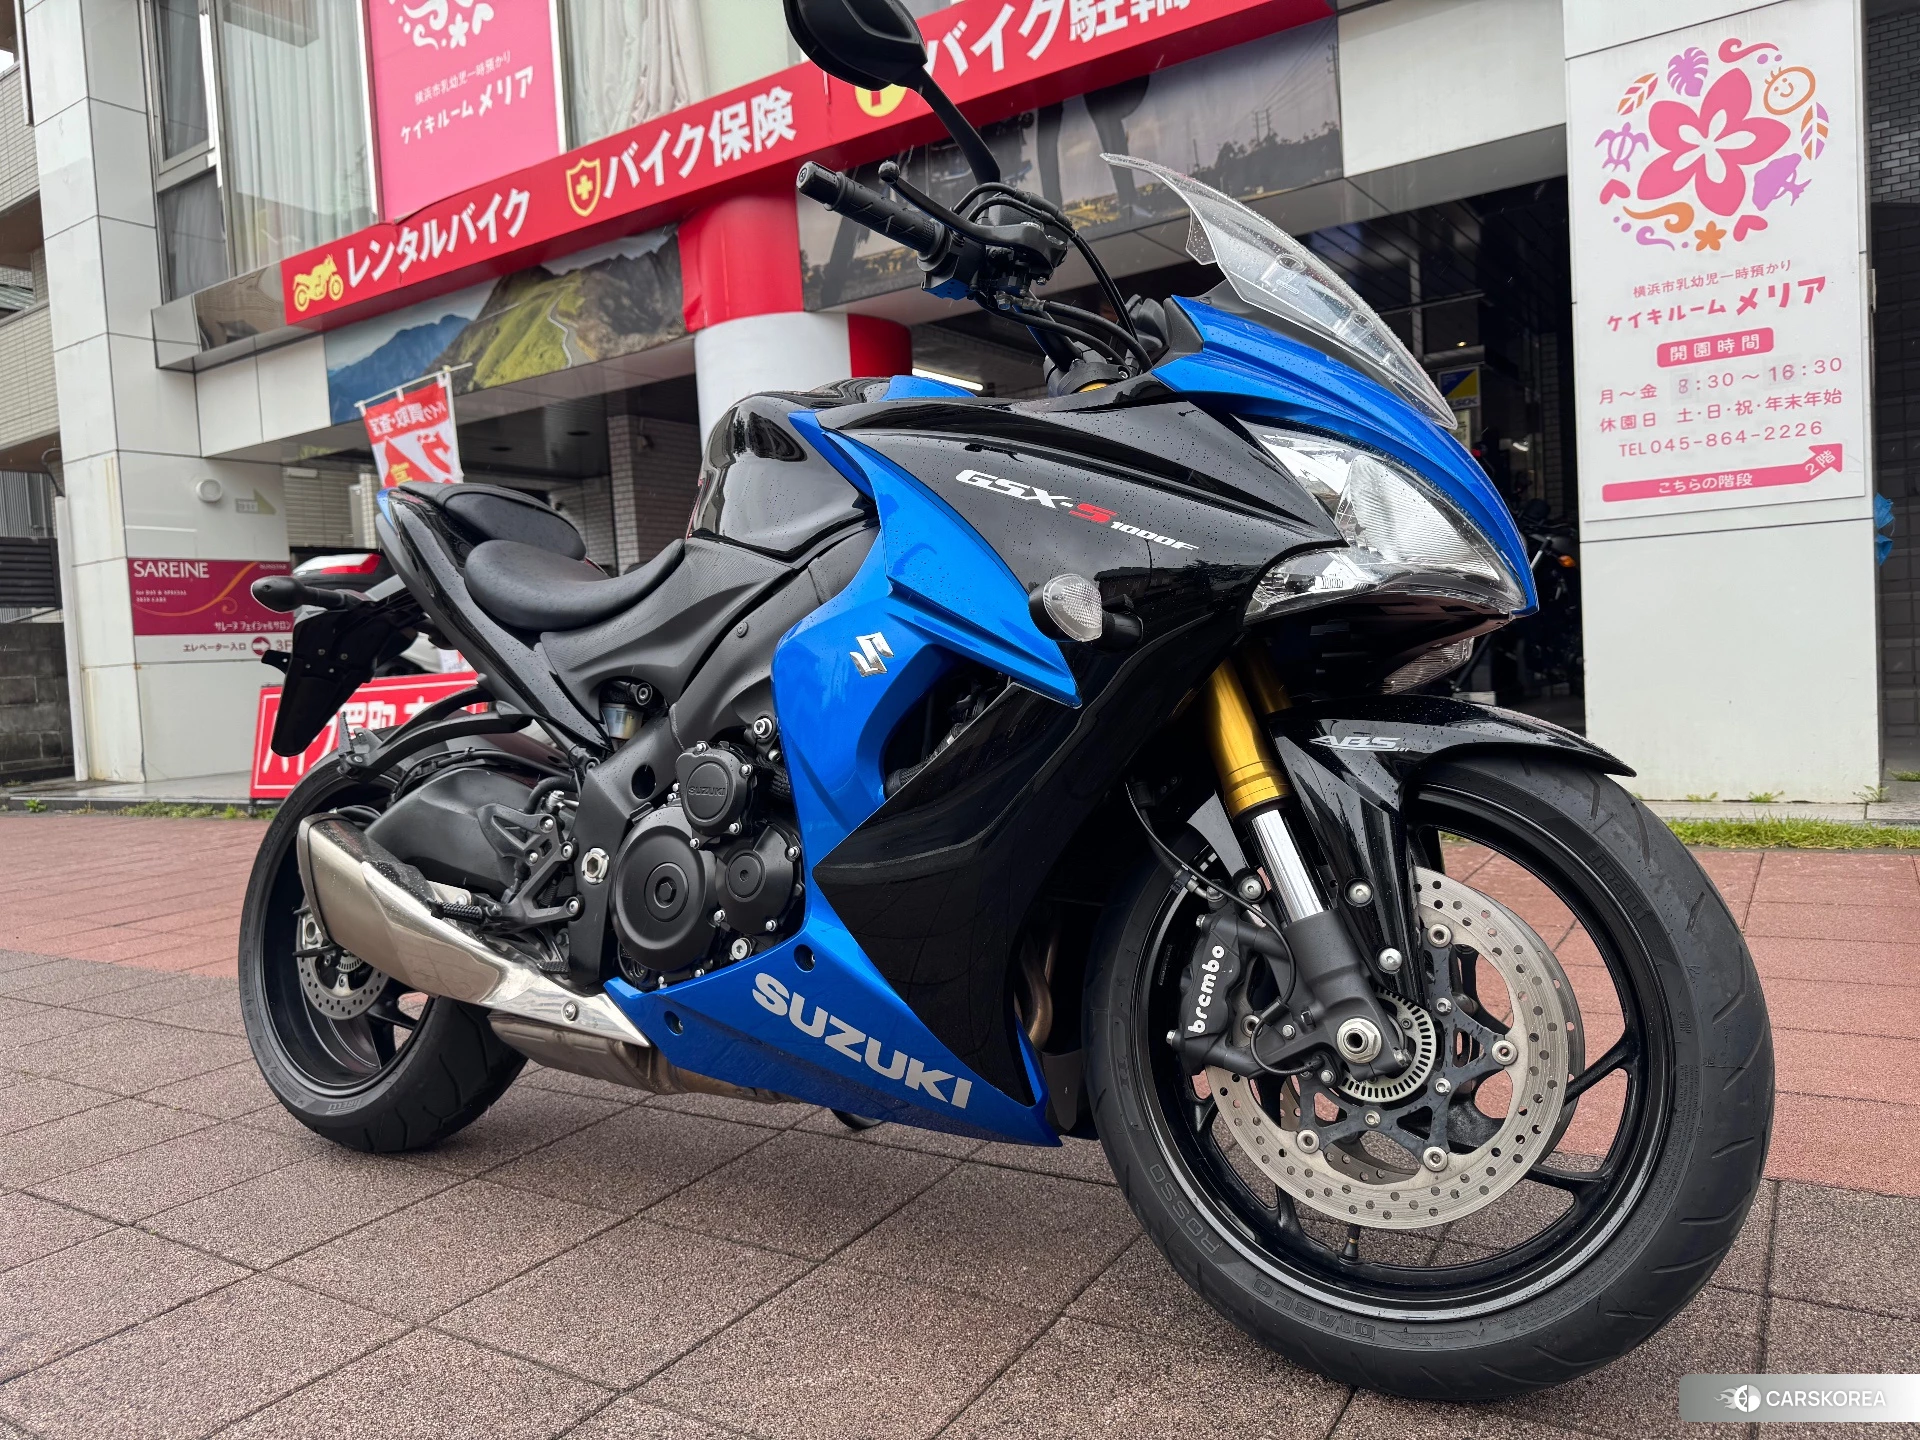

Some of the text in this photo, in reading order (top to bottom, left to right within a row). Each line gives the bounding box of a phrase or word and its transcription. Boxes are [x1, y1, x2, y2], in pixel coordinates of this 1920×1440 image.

[414, 50, 512, 106] 横浜市乳幼児一時預かり
[400, 65, 534, 145] ケイキルーム メリア
[602, 85, 798, 199] バイク保険
[346, 187, 531, 289] レンタルバイク
[1632, 259, 1792, 299] 横浜市乳幼児一時預かり
[1606, 275, 1827, 332] ケイキルーム メリア
[1669, 333, 1761, 362] 開園時間
[1599, 411, 1657, 433] 休園日
[1658, 473, 1754, 494] こちらの階段
[1804, 449, 1836, 476] 2階
[133, 561, 210, 579] SAREINE
[183, 642, 247, 653] エレベーター入口
[1309, 735, 1401, 750] ABS
[688, 786, 726, 797] SUZUKI
[1187, 945, 1225, 1034] brembo
[752, 972, 973, 1109] SUZUKI
[1150, 1163, 1224, 1254] ROSSO
[1252, 1278, 1376, 1341] DIABLO
